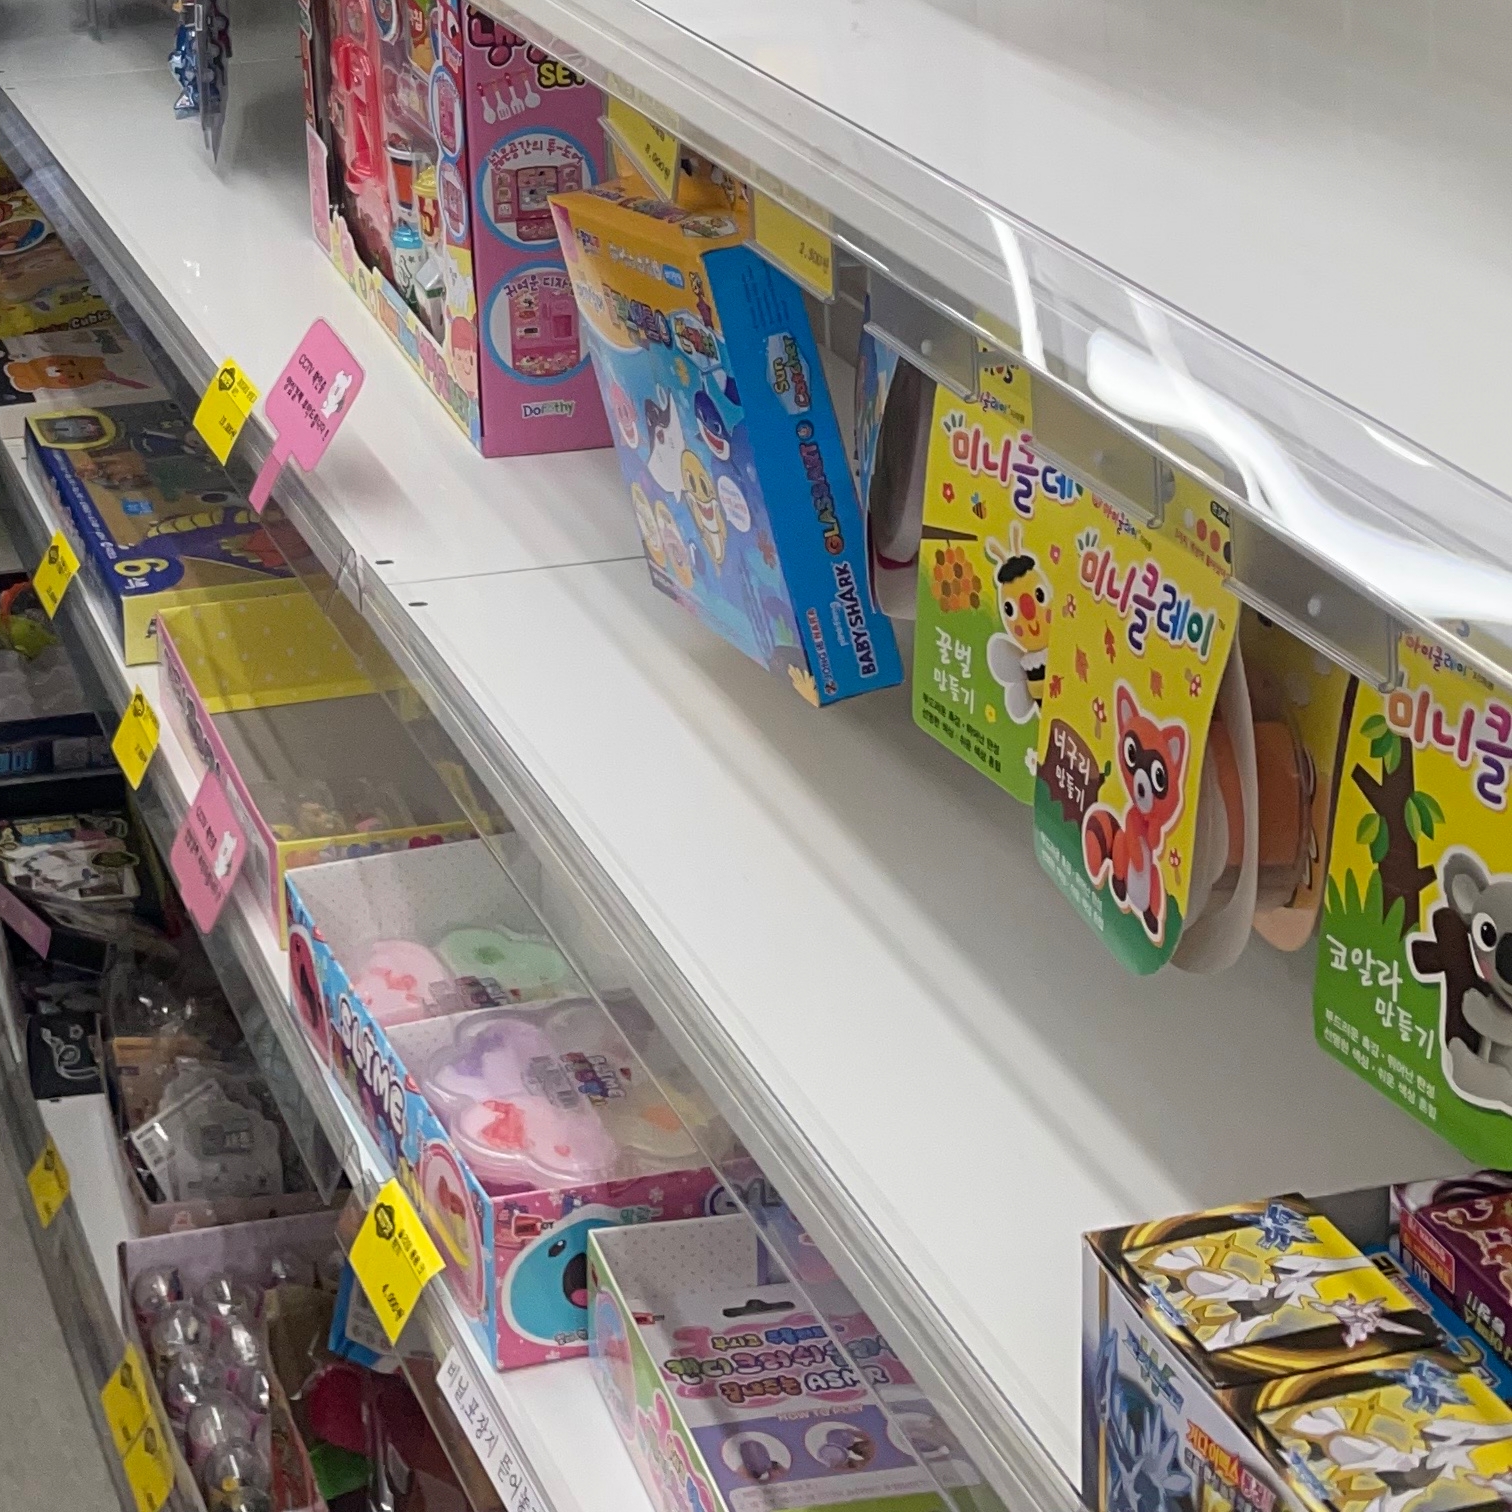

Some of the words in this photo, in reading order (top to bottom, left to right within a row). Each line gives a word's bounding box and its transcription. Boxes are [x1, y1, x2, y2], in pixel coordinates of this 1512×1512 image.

[773, 357, 790, 394] Sun
[952, 426, 1085, 515] 미니클레
[839, 561, 865, 629] SHARK
[1081, 548, 1217, 658] 미니클레이
[851, 626, 876, 678] BABY
[935, 625, 972, 679] 꿀벌
[933, 666, 975, 715] 만들기
[1053, 727, 1091, 787] 너구리
[1055, 763, 1085, 814] 만들기
[1326, 933, 1404, 1003] 코알라
[1375, 996, 1435, 1060] 만들기
[340, 996, 406, 1136] SLIME
[803, 1364, 891, 1392] ASMR
